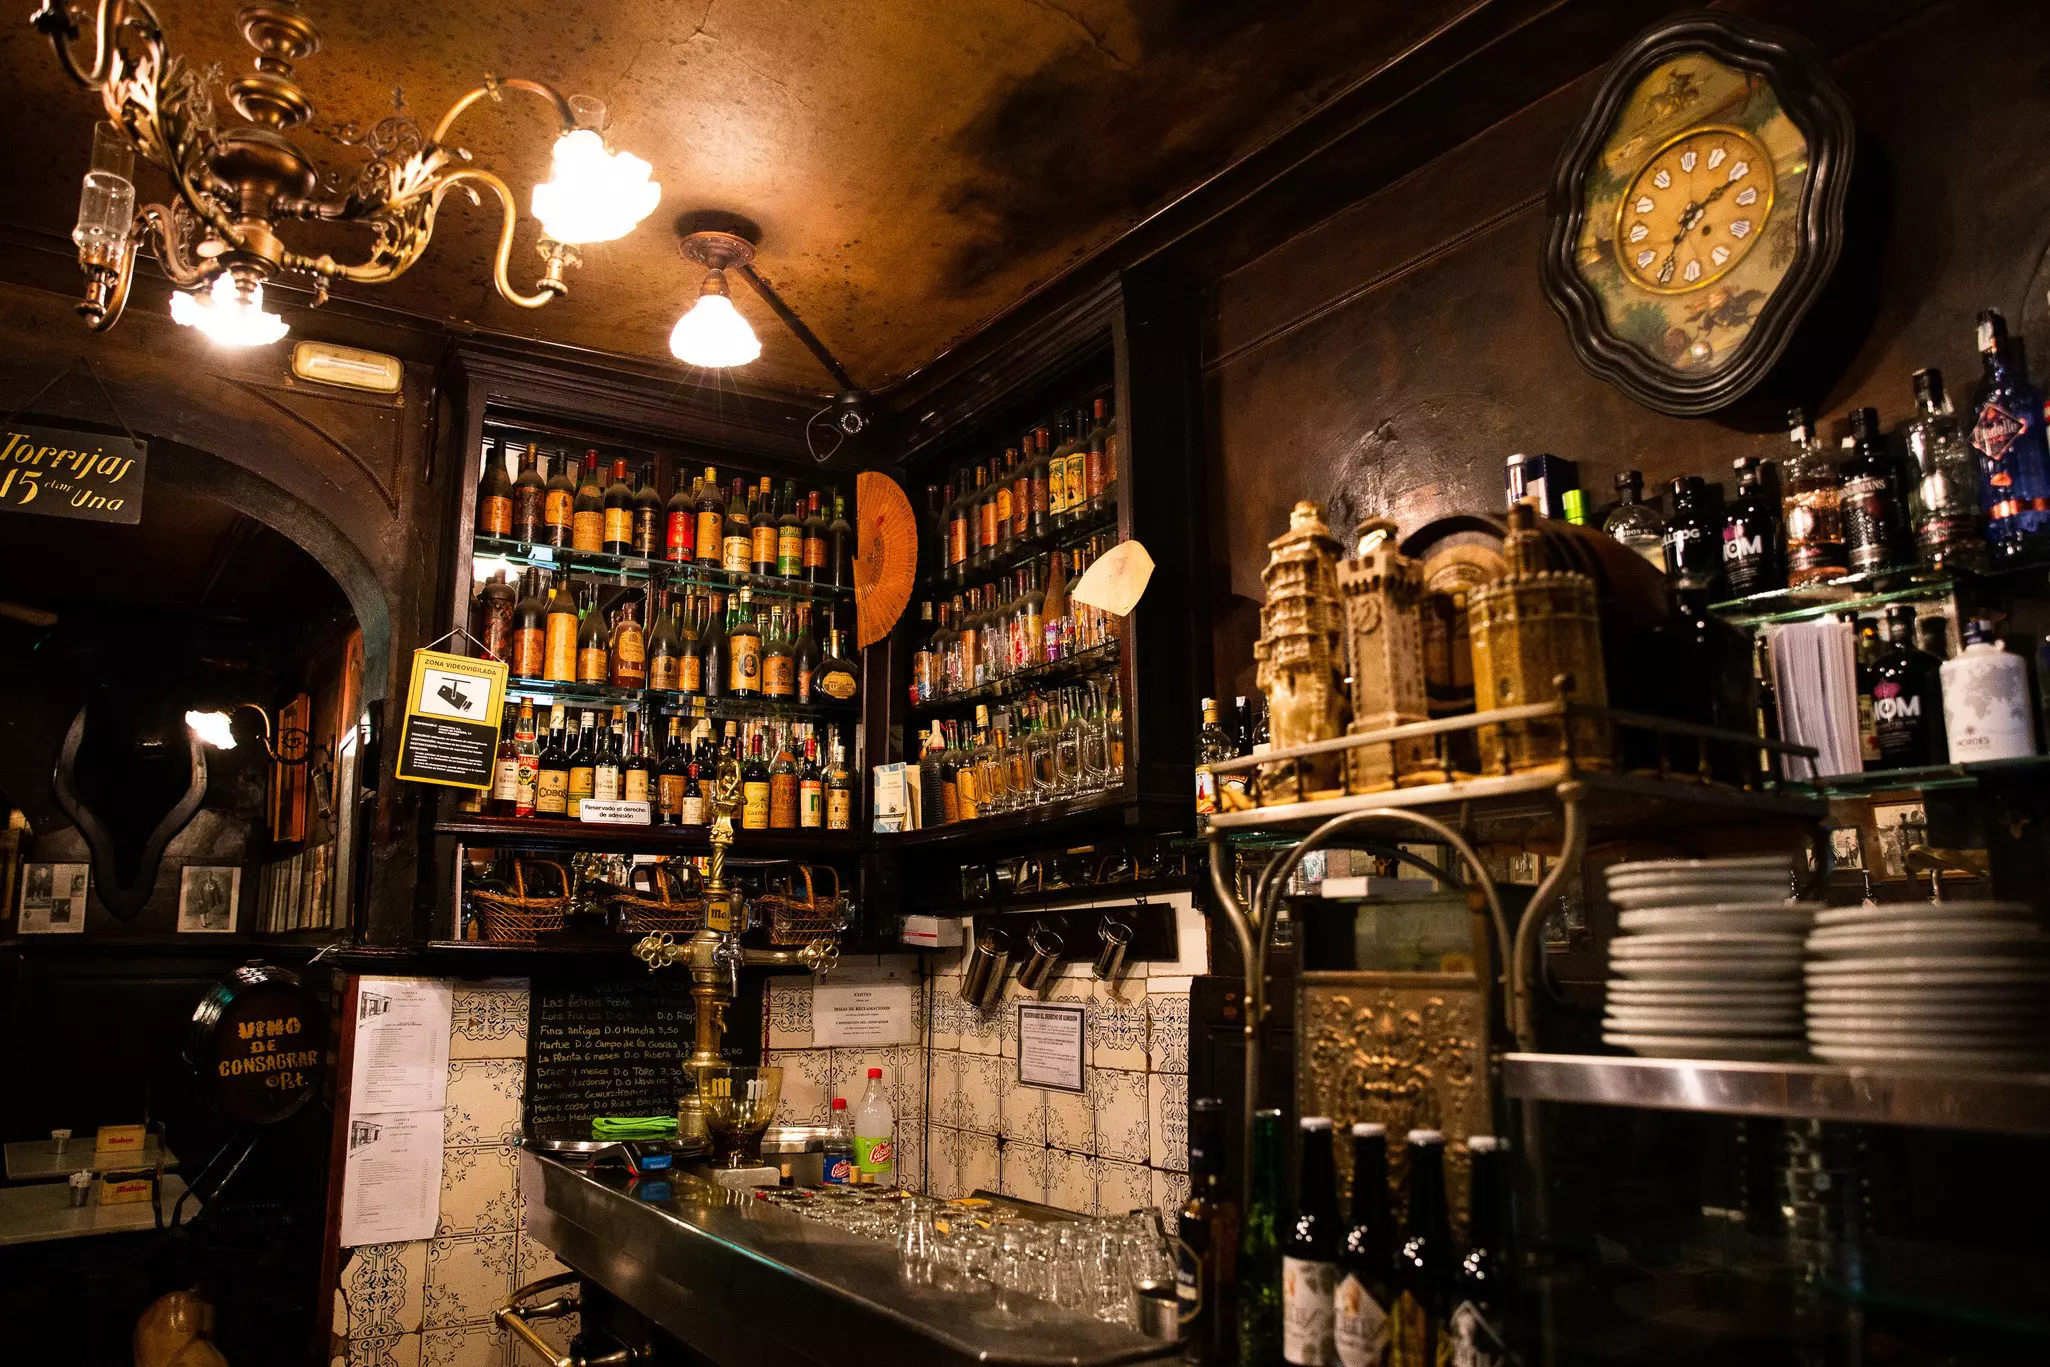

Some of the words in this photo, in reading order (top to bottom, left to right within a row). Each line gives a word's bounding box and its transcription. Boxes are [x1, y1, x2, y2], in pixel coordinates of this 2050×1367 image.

[0, 432, 136, 484] Torrijas
[0, 468, 43, 505] 15
[70, 489, 125, 512] Una
[424, 659, 444, 668] ZONA
[446, 662, 497, 676] VIDEOVIGILADA
[584, 804, 615, 812] Reservado
[542, 997, 564, 1008] Las
[238, 1016, 301, 1039] VINO
[540, 1025, 563, 1037] Finca
[567, 1022, 602, 1040] antigua
[622, 1025, 655, 1036] Mancha
[249, 1039, 277, 1054] DE
[595, 1038, 623, 1051] Campo
[217, 1050, 319, 1077] CONSAGRAR
[538, 1054, 549, 1064] La
[584, 1051, 591, 1061] 6
[722, 1047, 744, 1057] 3,80
